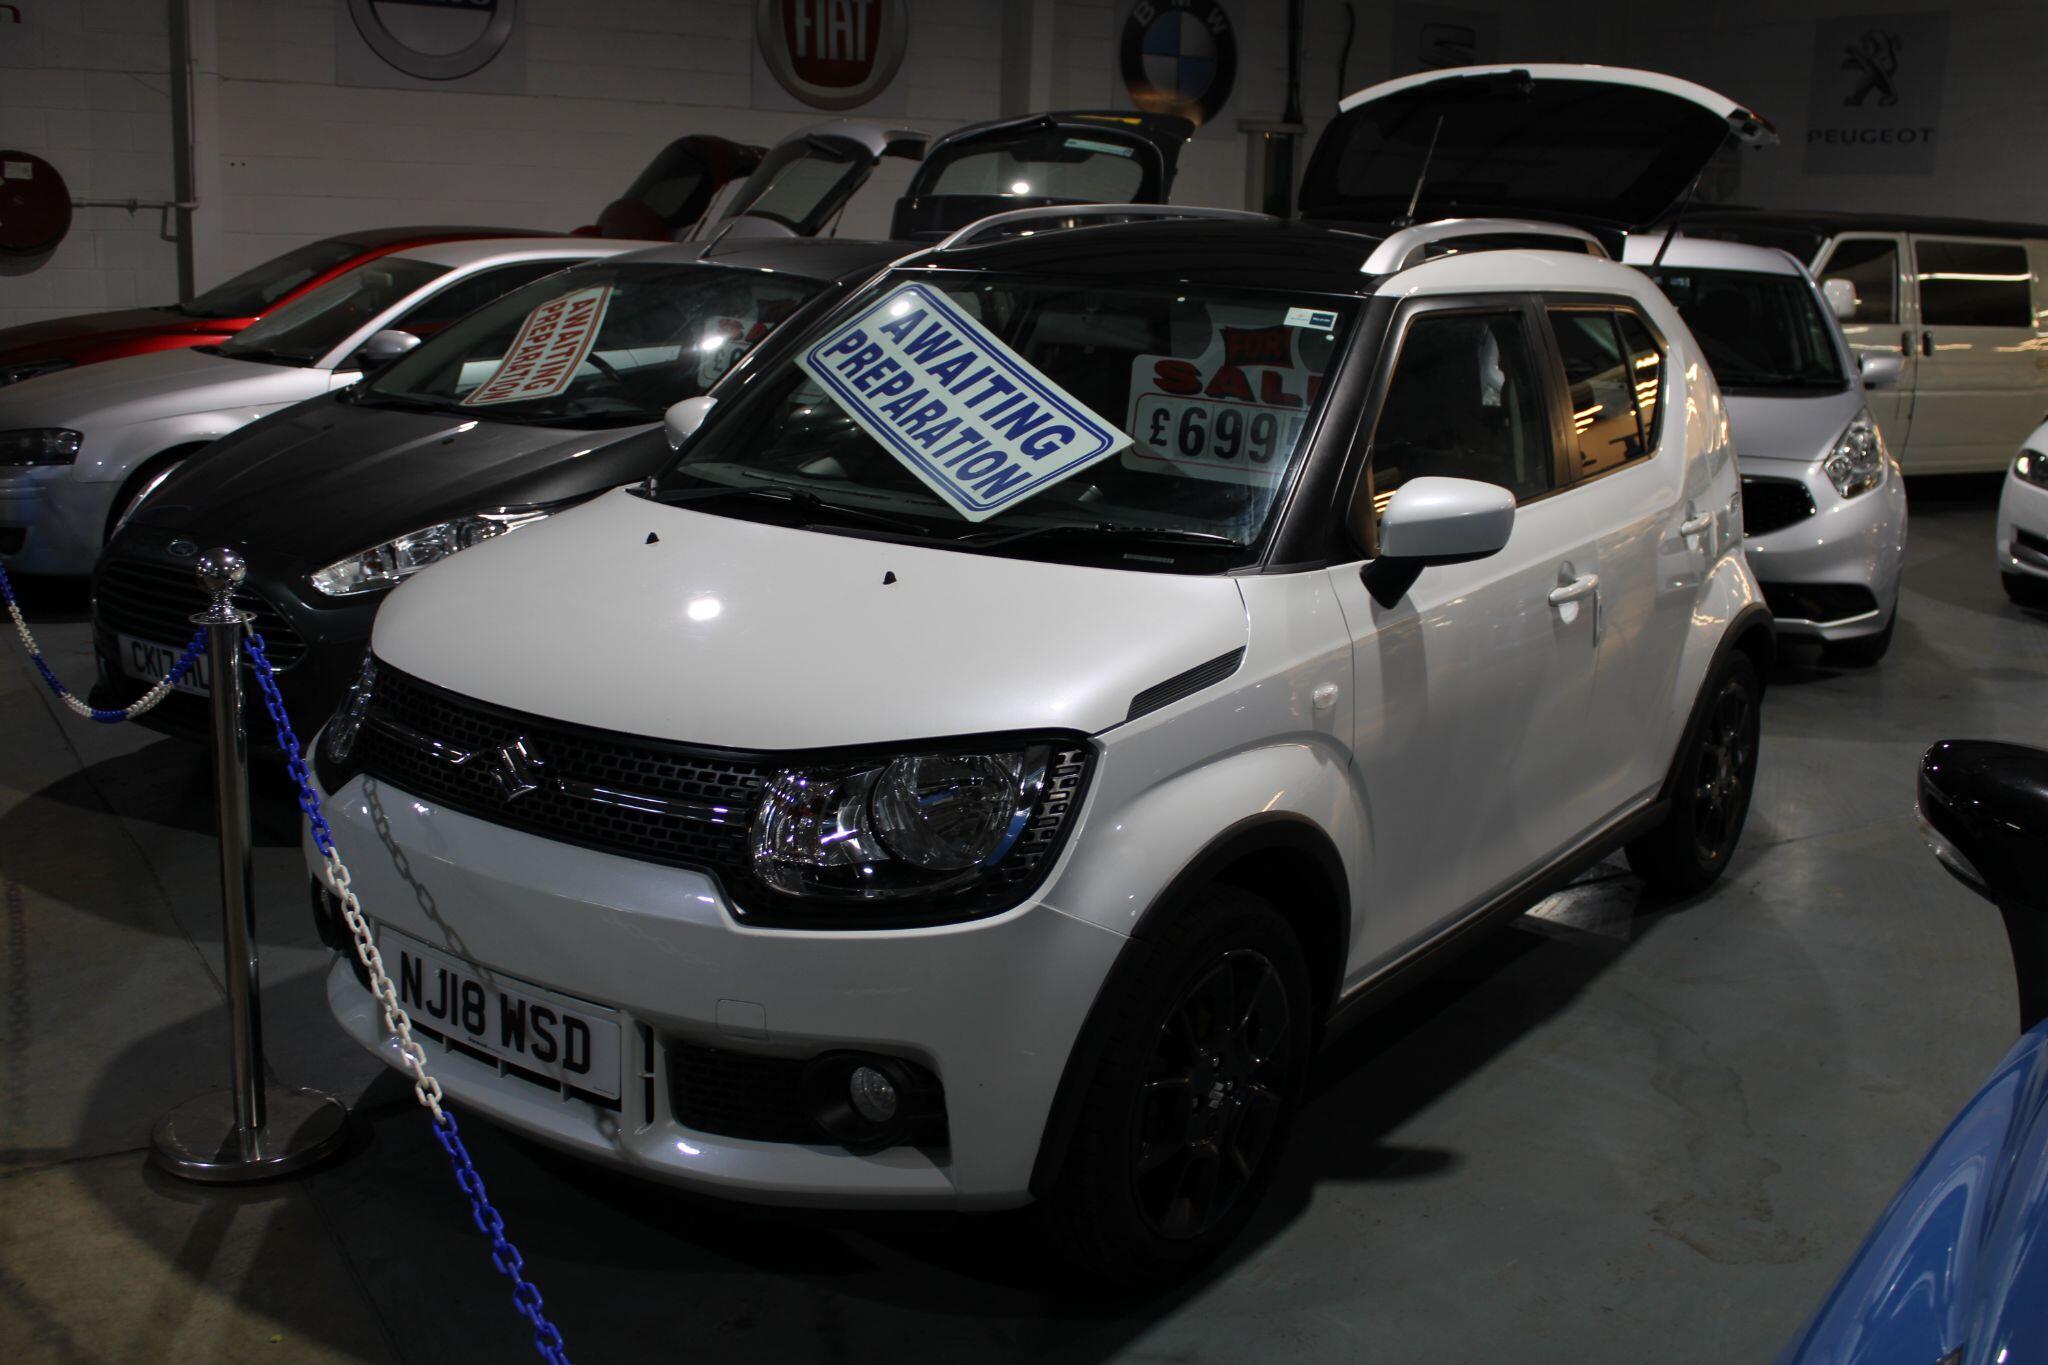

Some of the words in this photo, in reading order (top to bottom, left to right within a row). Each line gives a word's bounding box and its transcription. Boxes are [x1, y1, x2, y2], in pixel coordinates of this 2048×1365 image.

[795, 0, 875, 61] FIAT
[1806, 127, 1936, 145] PEUGEOT
[478, 300, 568, 401] PREPARATION
[522, 297, 598, 392] AWAITING
[879, 308, 1077, 462] AWAITING
[822, 329, 1034, 500] PREPARATION
[400, 950, 486, 1037] NJ18
[500, 992, 591, 1076] WSD
